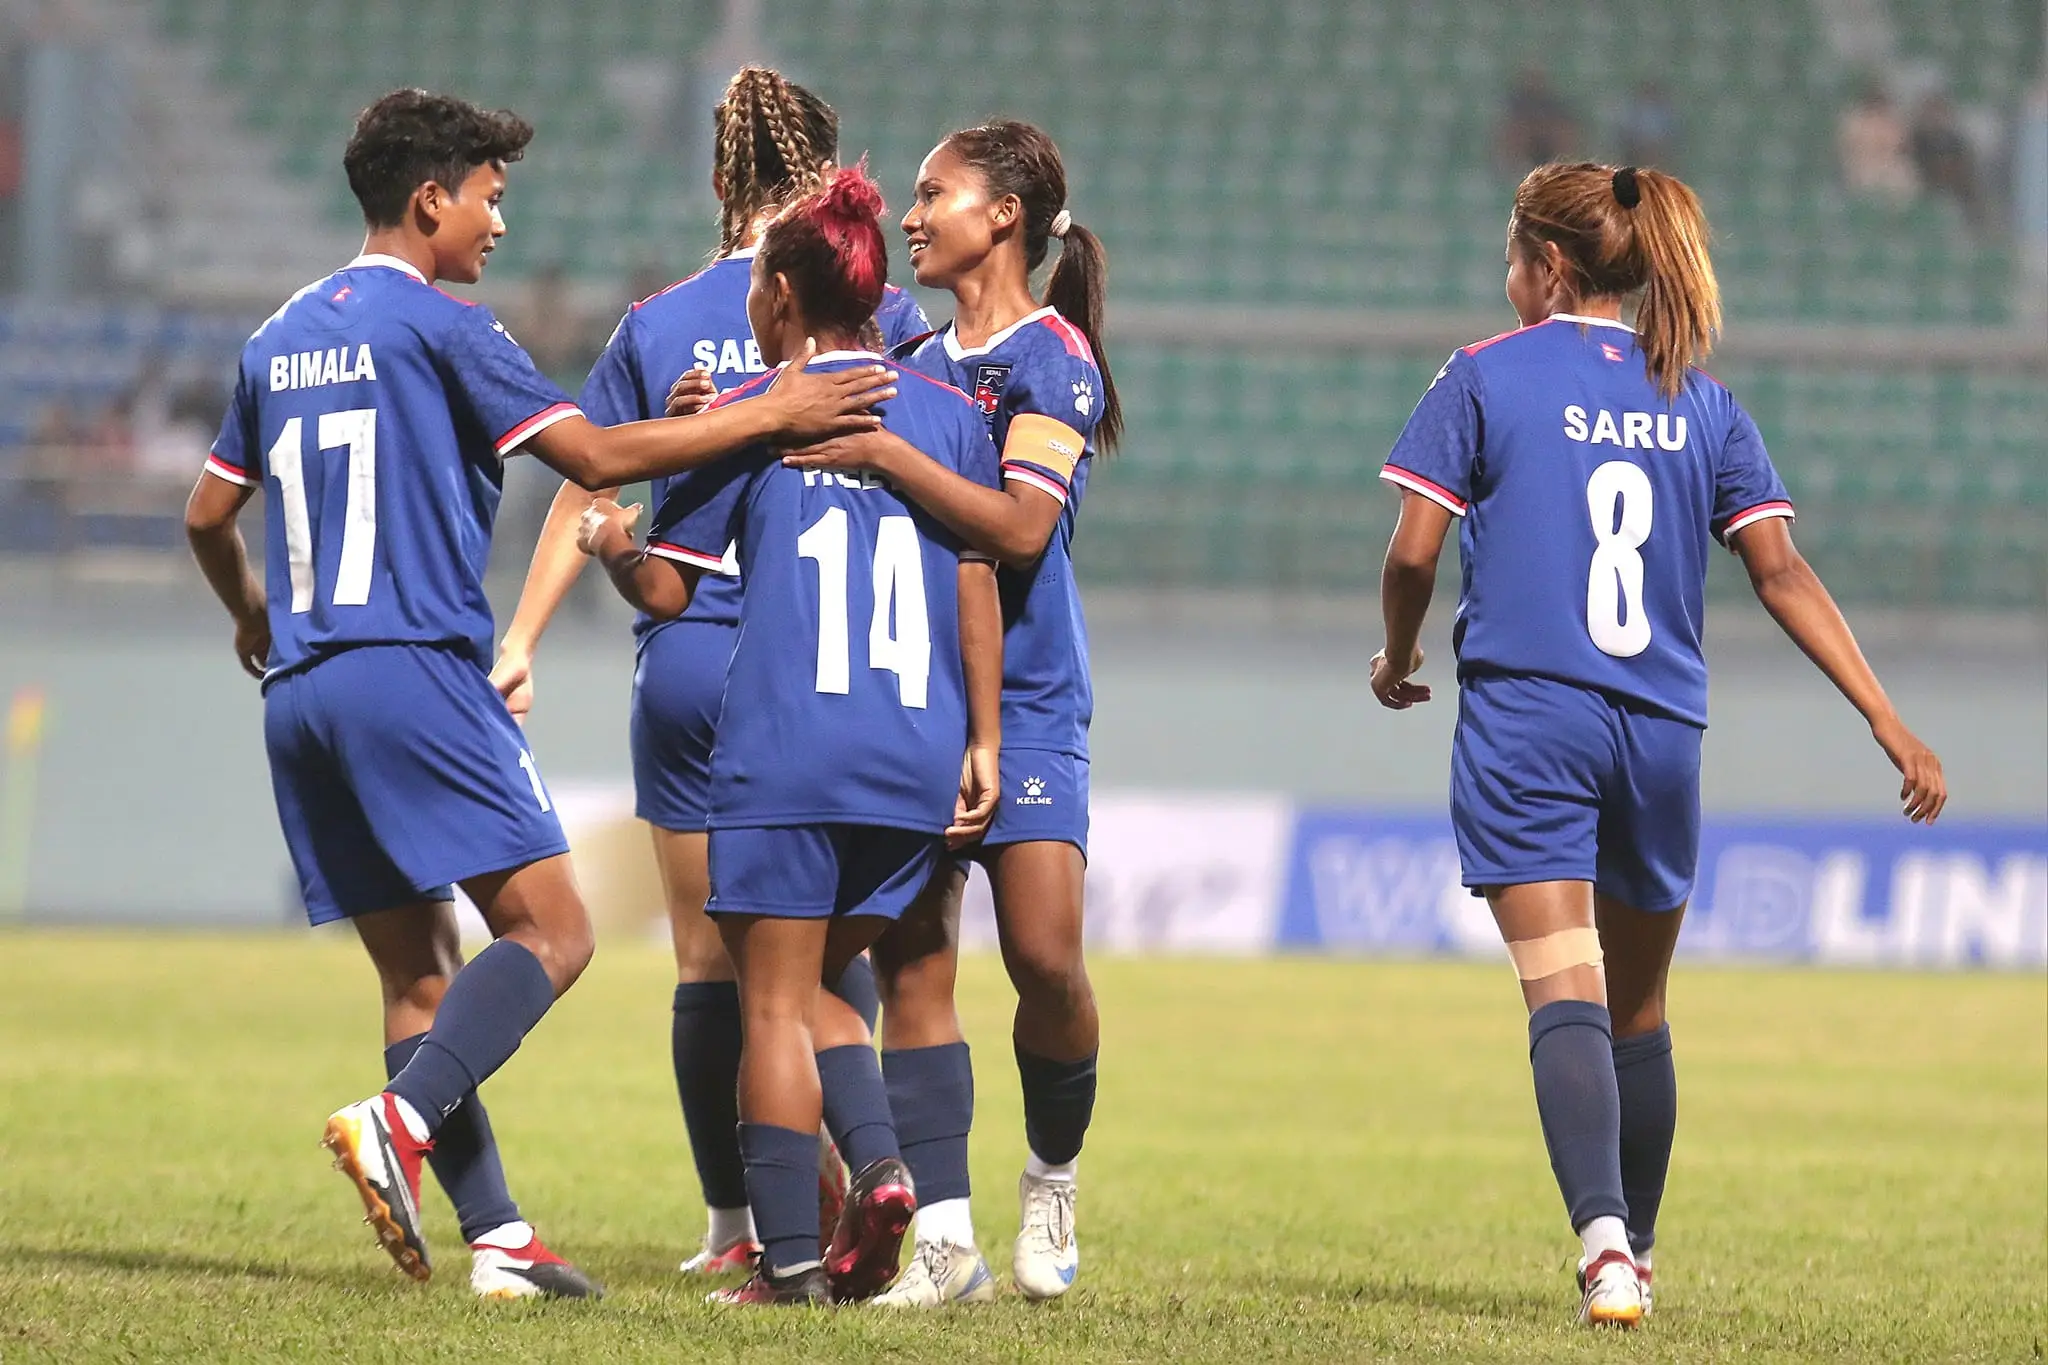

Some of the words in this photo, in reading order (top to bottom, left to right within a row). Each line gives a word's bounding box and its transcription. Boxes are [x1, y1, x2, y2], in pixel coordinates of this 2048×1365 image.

[270, 343, 376, 392] BIMALA
[693, 339, 770, 374] SAB
[1563, 404, 1687, 452] SARU
[268, 408, 377, 614] 17
[1586, 460, 1653, 658] 8
[797, 506, 931, 710] 14
[518, 748, 551, 813] 1
[1016, 797, 1053, 805] KELME
